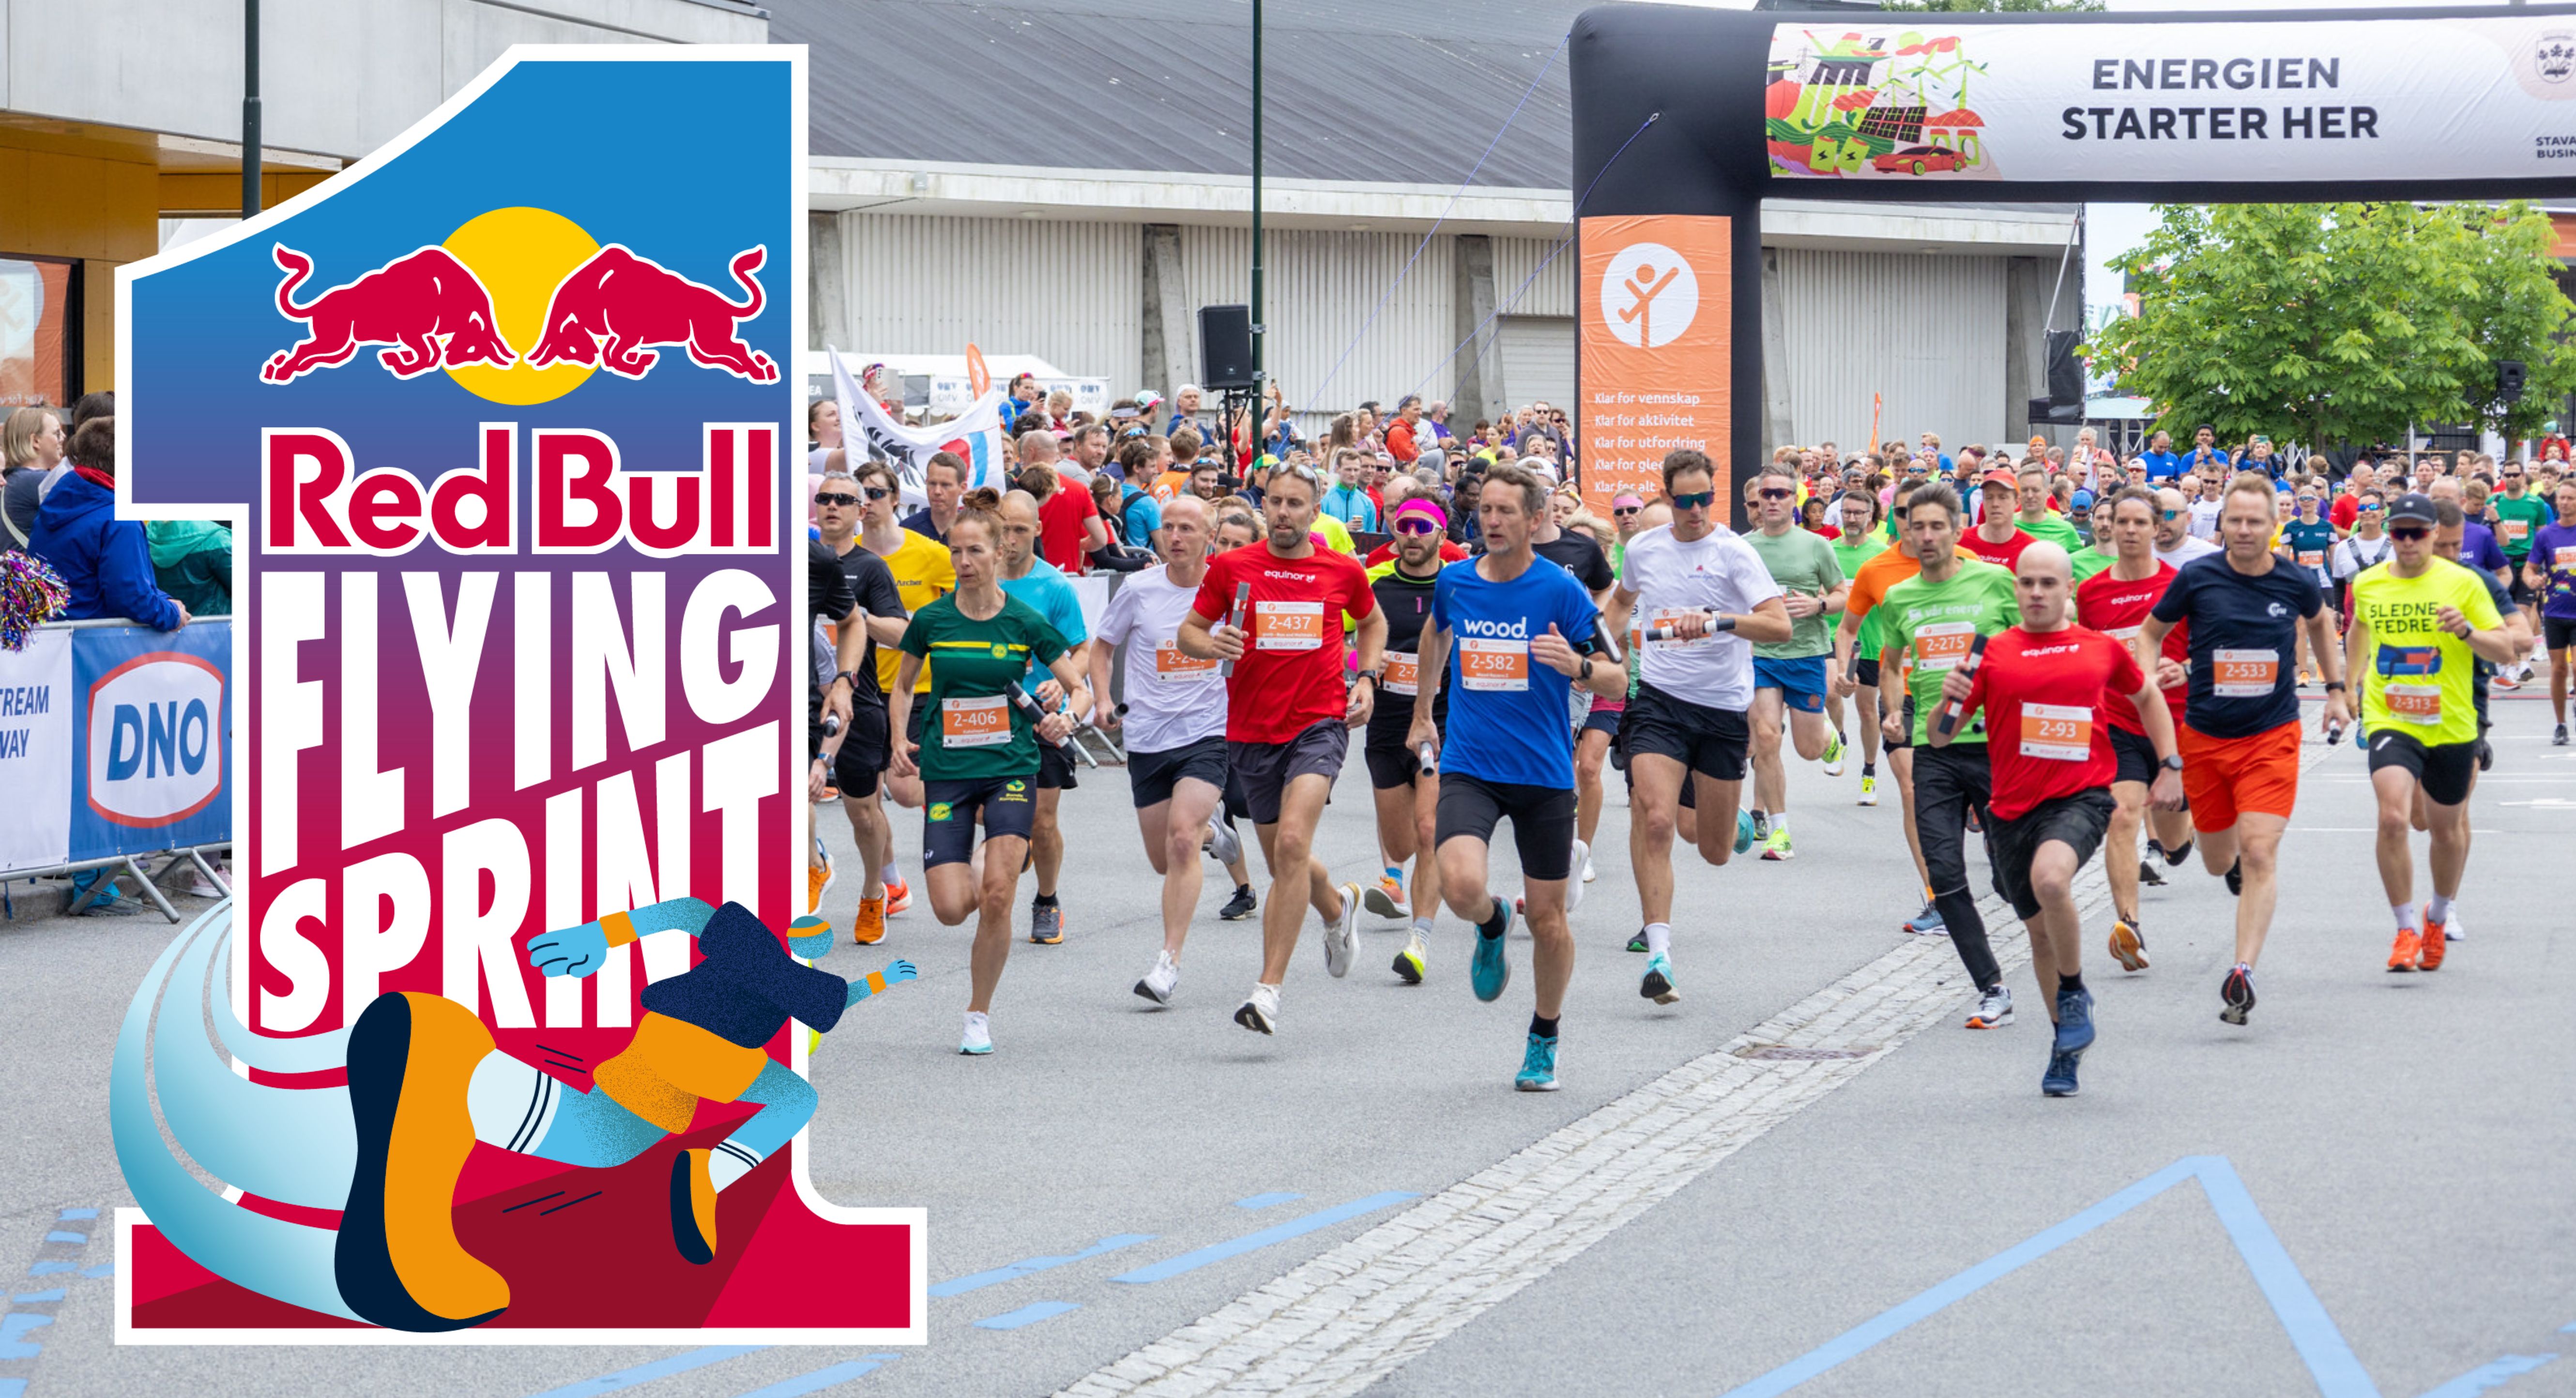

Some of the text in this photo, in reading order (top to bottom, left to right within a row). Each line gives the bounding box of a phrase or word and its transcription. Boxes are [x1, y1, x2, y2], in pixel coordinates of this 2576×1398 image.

[2092, 57, 2340, 91] ENERGIEN
[2061, 106, 2379, 140] STARTER HER
[1595, 391, 1700, 406] Klar for vennskap
[1595, 414, 1695, 427] Klar for aktivitet
[1595, 436, 1706, 450] Klar for utfordring
[1595, 459, 1615, 471] Klar
[1617, 458, 1635, 471] for
[1595, 480, 1615, 492] Klar
[1638, 480, 1656, 492] alt
[1979, 554, 2001, 563] quinor
[1264, 569, 1305, 581] equinor
[2111, 595, 2144, 605] equinor
[1945, 600, 1983, 616] energi
[2370, 601, 2439, 618] SLEDNE
[1268, 615, 1311, 630] 2-437
[2374, 618, 2432, 633] FEDRE
[1926, 635, 1966, 652] 2-275
[2021, 645, 2069, 658] equinor
[1470, 654, 1515, 671] 2-582
[2225, 663, 2267, 677] 2-533
[2393, 696, 2431, 709] 2-313
[953, 710, 997, 727] 2-406
[2039, 720, 2077, 738] 2-93
[106, 697, 209, 782] DNO
